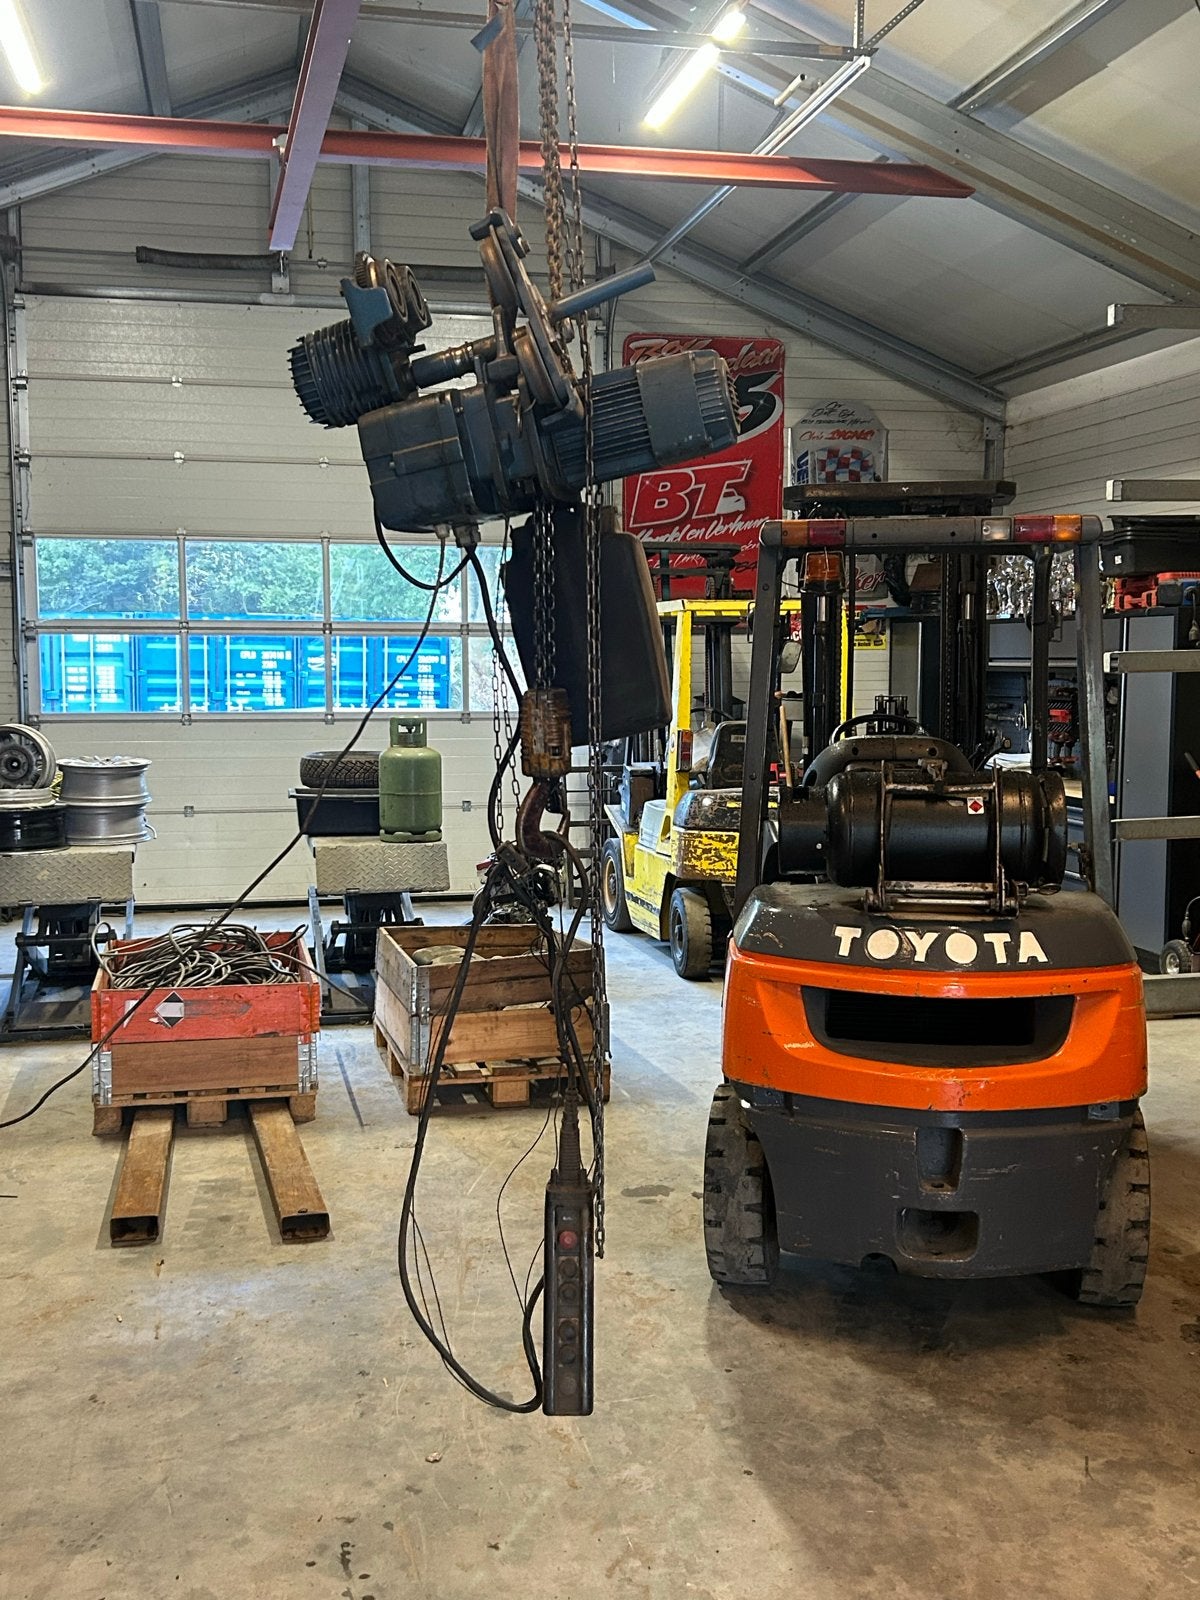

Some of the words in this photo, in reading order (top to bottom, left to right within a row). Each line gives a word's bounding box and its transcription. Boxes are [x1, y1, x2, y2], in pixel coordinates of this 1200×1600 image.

[629, 459, 752, 528] BT
[686, 527, 705, 540] en
[834, 925, 1049, 965] TOYOTA
